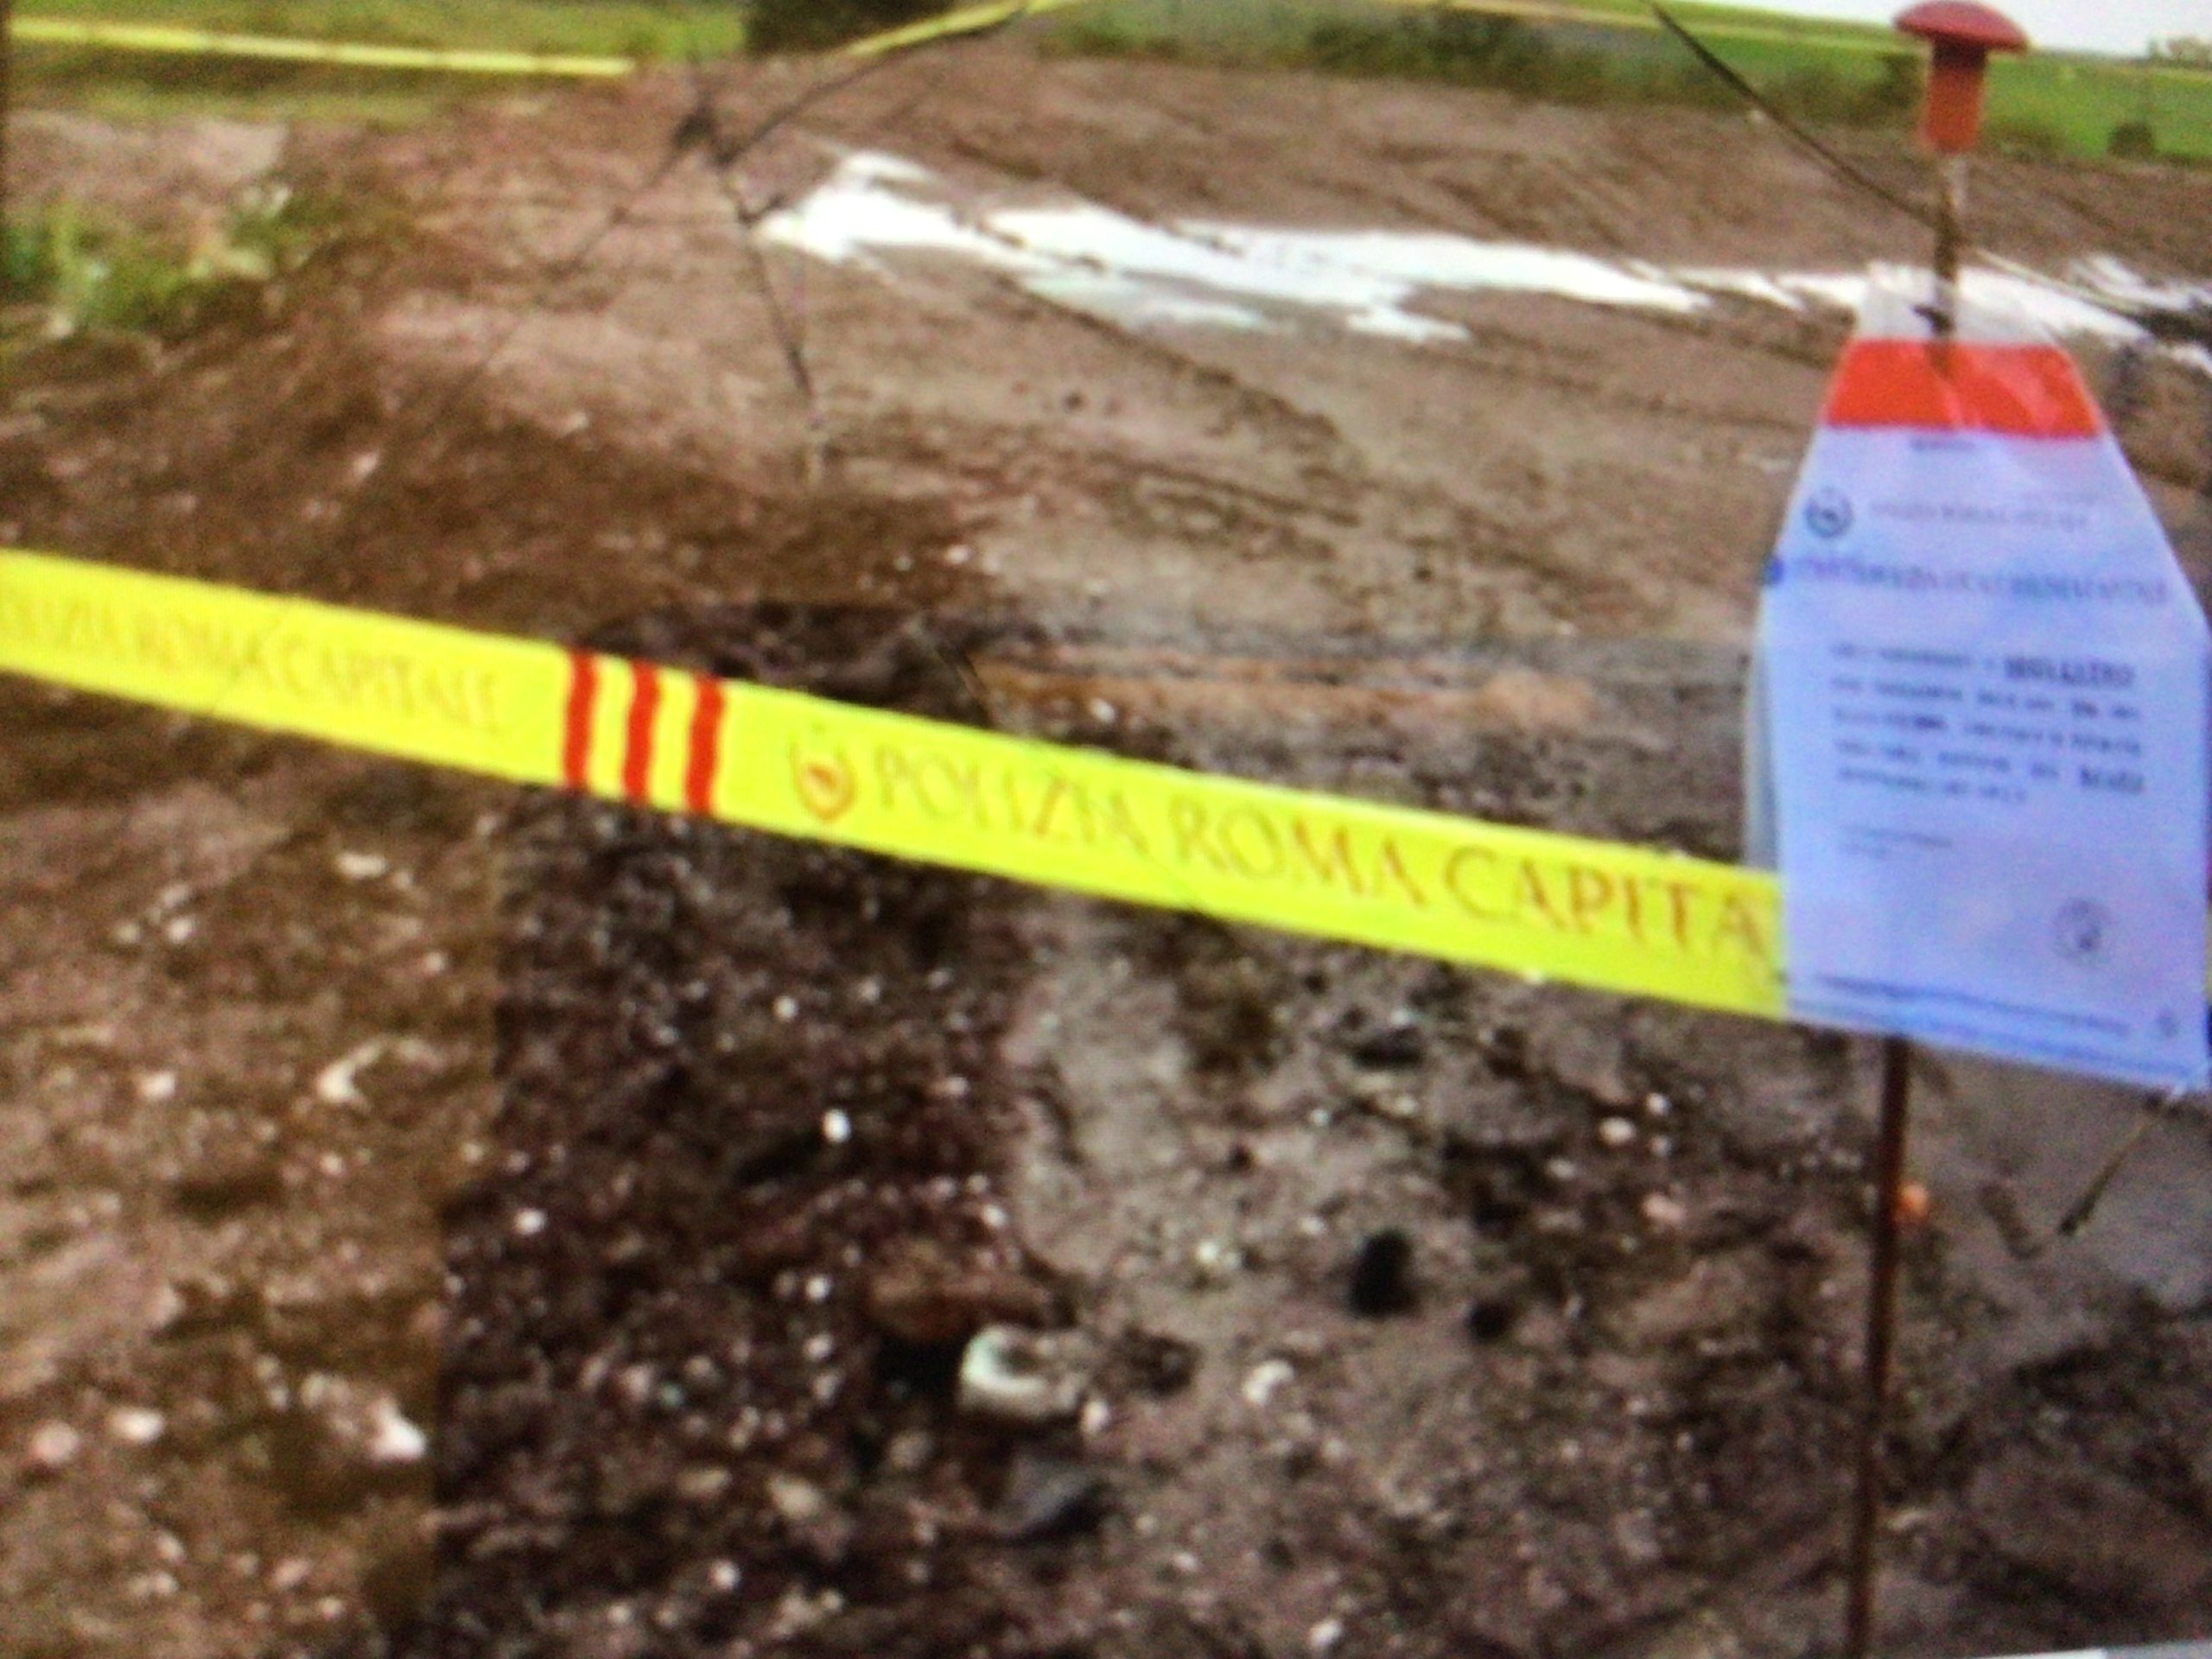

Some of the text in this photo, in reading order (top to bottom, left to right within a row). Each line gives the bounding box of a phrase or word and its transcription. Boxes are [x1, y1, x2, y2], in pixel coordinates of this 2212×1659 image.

[131, 612, 274, 686] ROMA
[873, 743, 1153, 855] POLIZIA
[1167, 793, 1427, 908] ROMA
